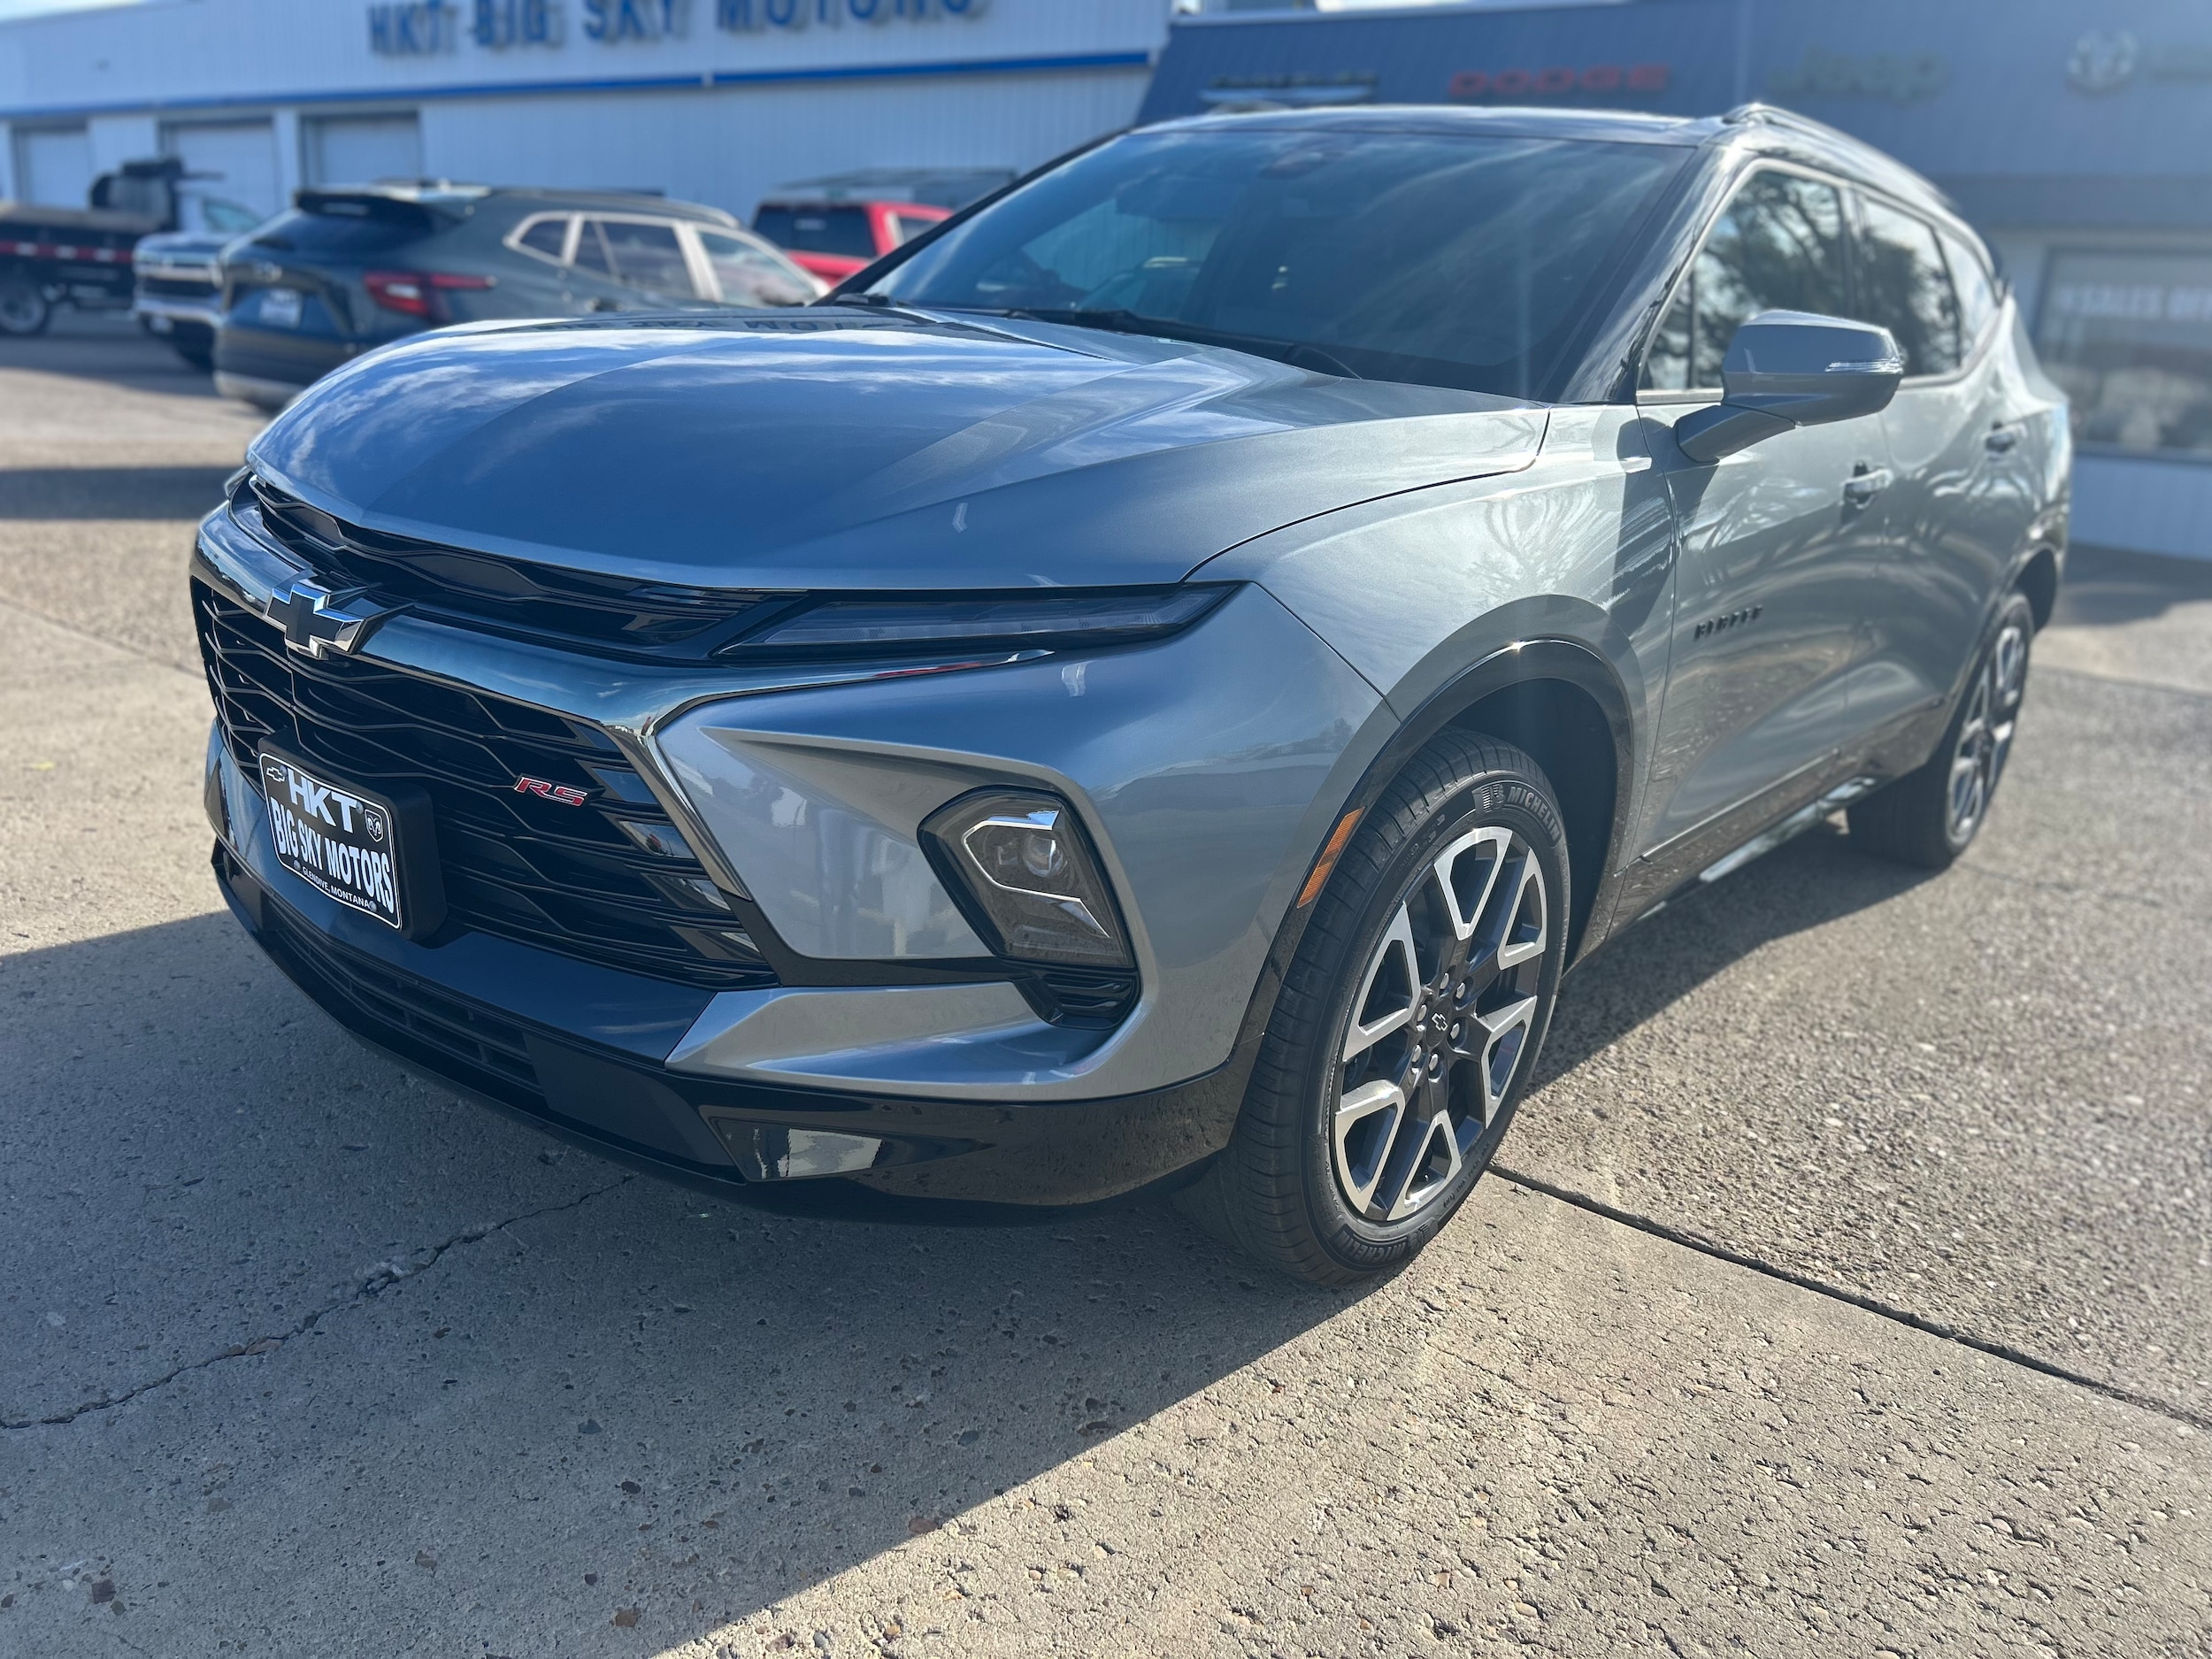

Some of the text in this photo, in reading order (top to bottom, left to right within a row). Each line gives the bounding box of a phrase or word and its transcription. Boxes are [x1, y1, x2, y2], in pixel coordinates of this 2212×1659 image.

[581, 0, 683, 39] SKY
[717, 0, 979, 31] MOT
[1449, 65, 1669, 96] DODGE
[288, 768, 357, 833] HKT
[514, 777, 588, 806] RS
[1507, 786, 1560, 841] MICHELIN
[270, 796, 395, 914] BIG SKY MOTORS
[331, 885, 371, 910] MONTANA
